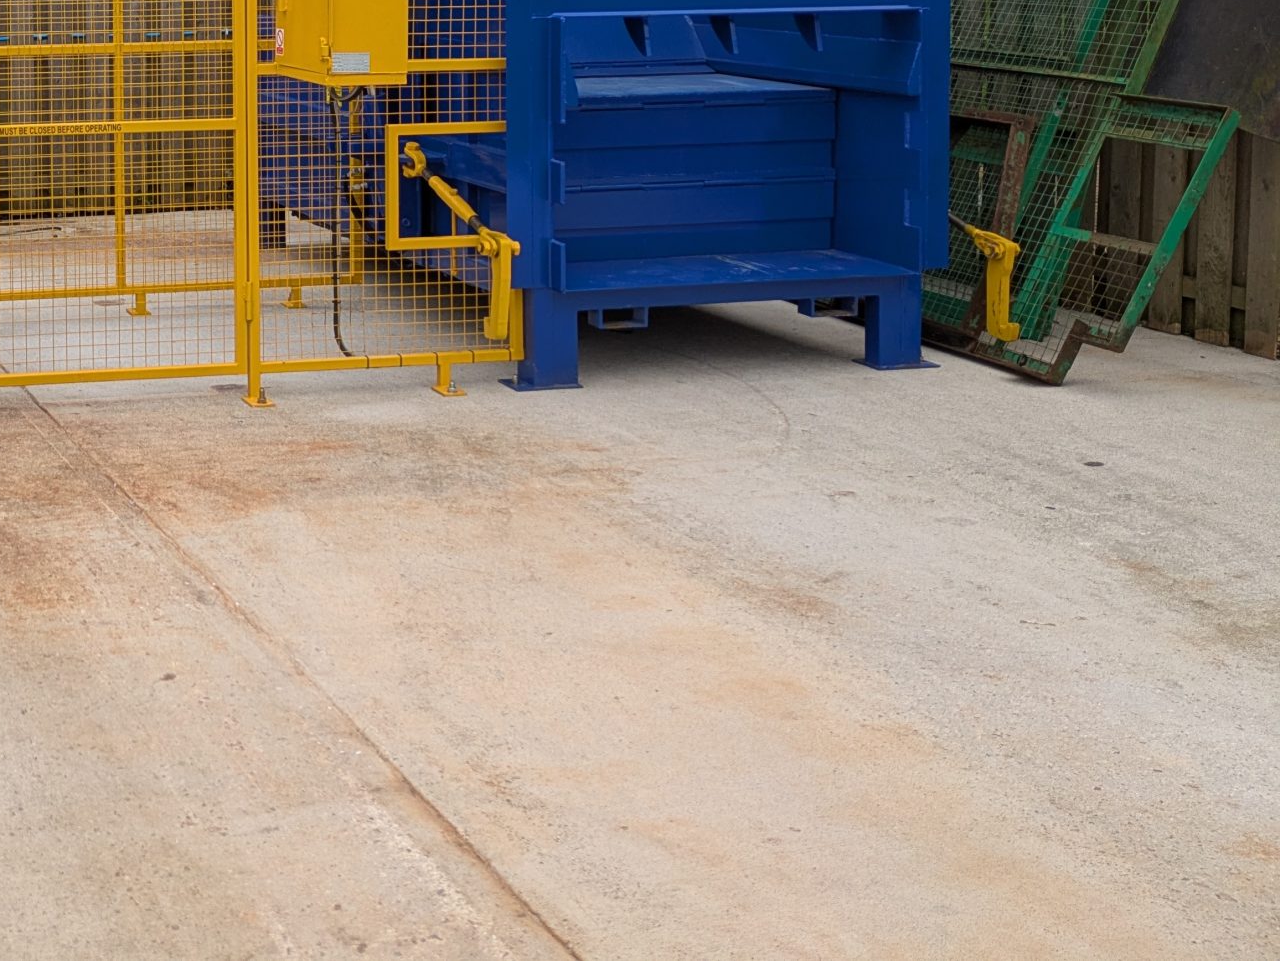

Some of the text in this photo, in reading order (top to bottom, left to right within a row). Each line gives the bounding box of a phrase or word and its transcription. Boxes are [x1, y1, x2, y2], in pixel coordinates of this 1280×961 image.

[0, 127, 17, 136] MUST
[18, 127, 28, 135] BE
[29, 126, 56, 135] CLOSED
[57, 125, 84, 134] BEFORE
[85, 123, 122, 133] OPERATING
